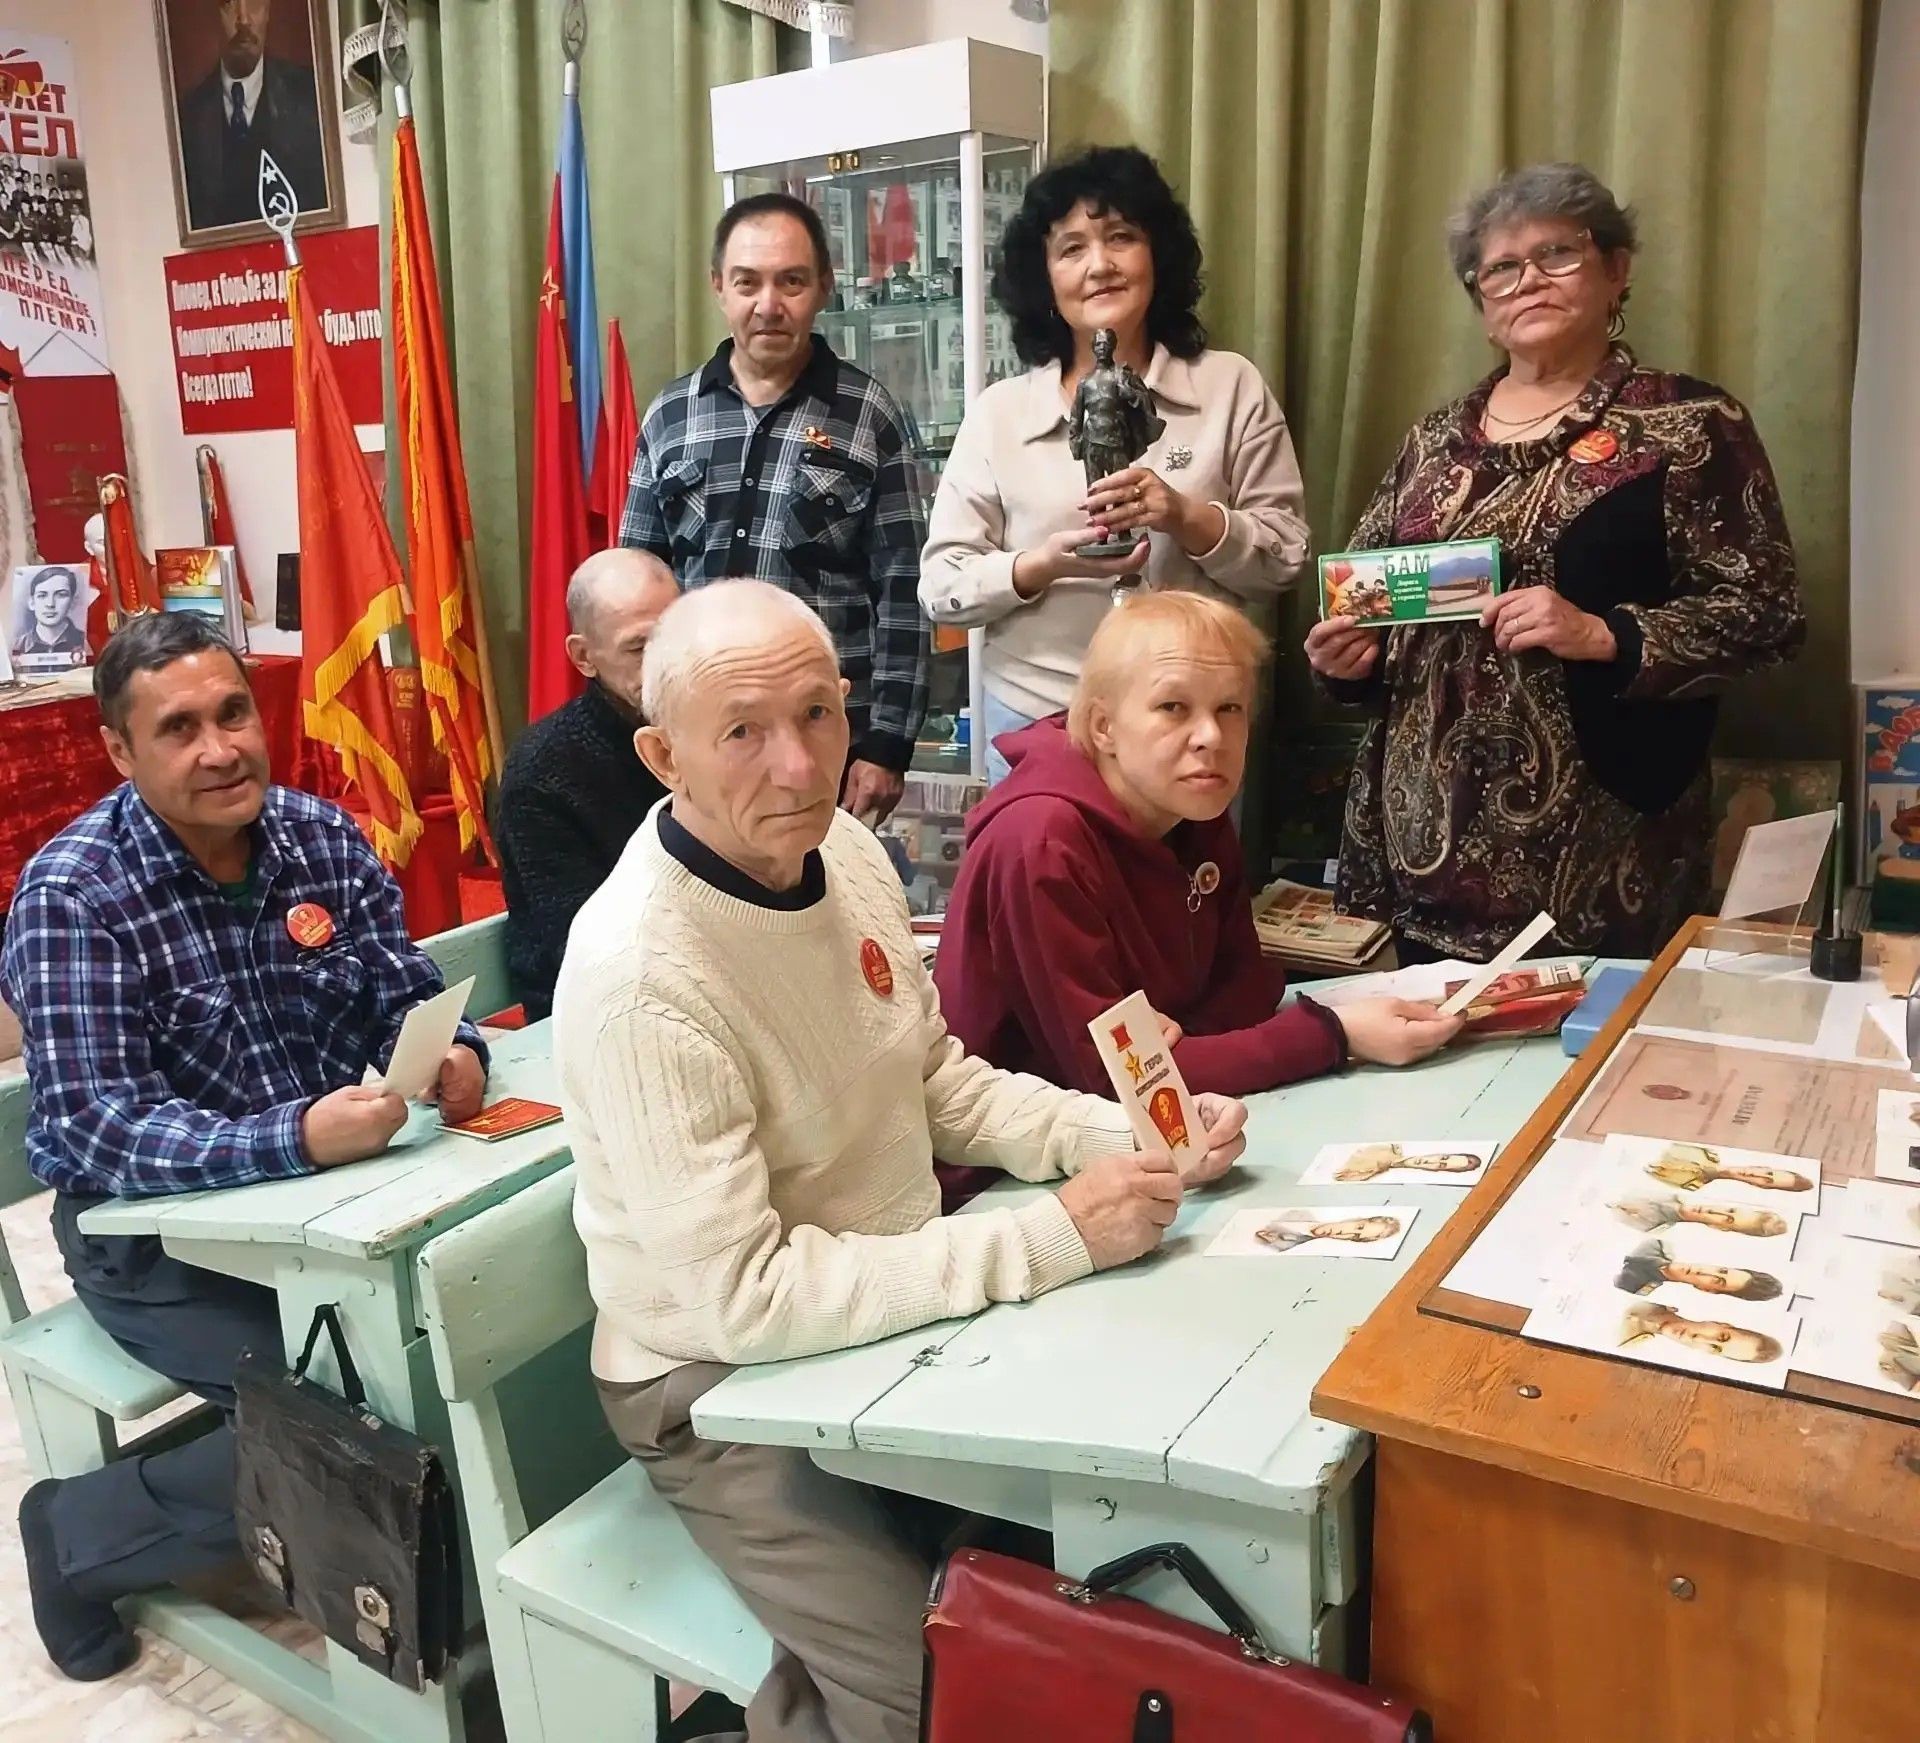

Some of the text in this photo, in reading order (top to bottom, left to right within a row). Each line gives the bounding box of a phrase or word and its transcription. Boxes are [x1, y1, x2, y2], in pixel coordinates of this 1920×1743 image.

[0, 272, 91, 318] ОМСОМОЛЬСКОЕ
[18, 297, 97, 337] ПЛЕМЯ!
[324, 308, 356, 347] будь
[355, 308, 382, 340] гото
[1384, 552, 1430, 576] БАМ
